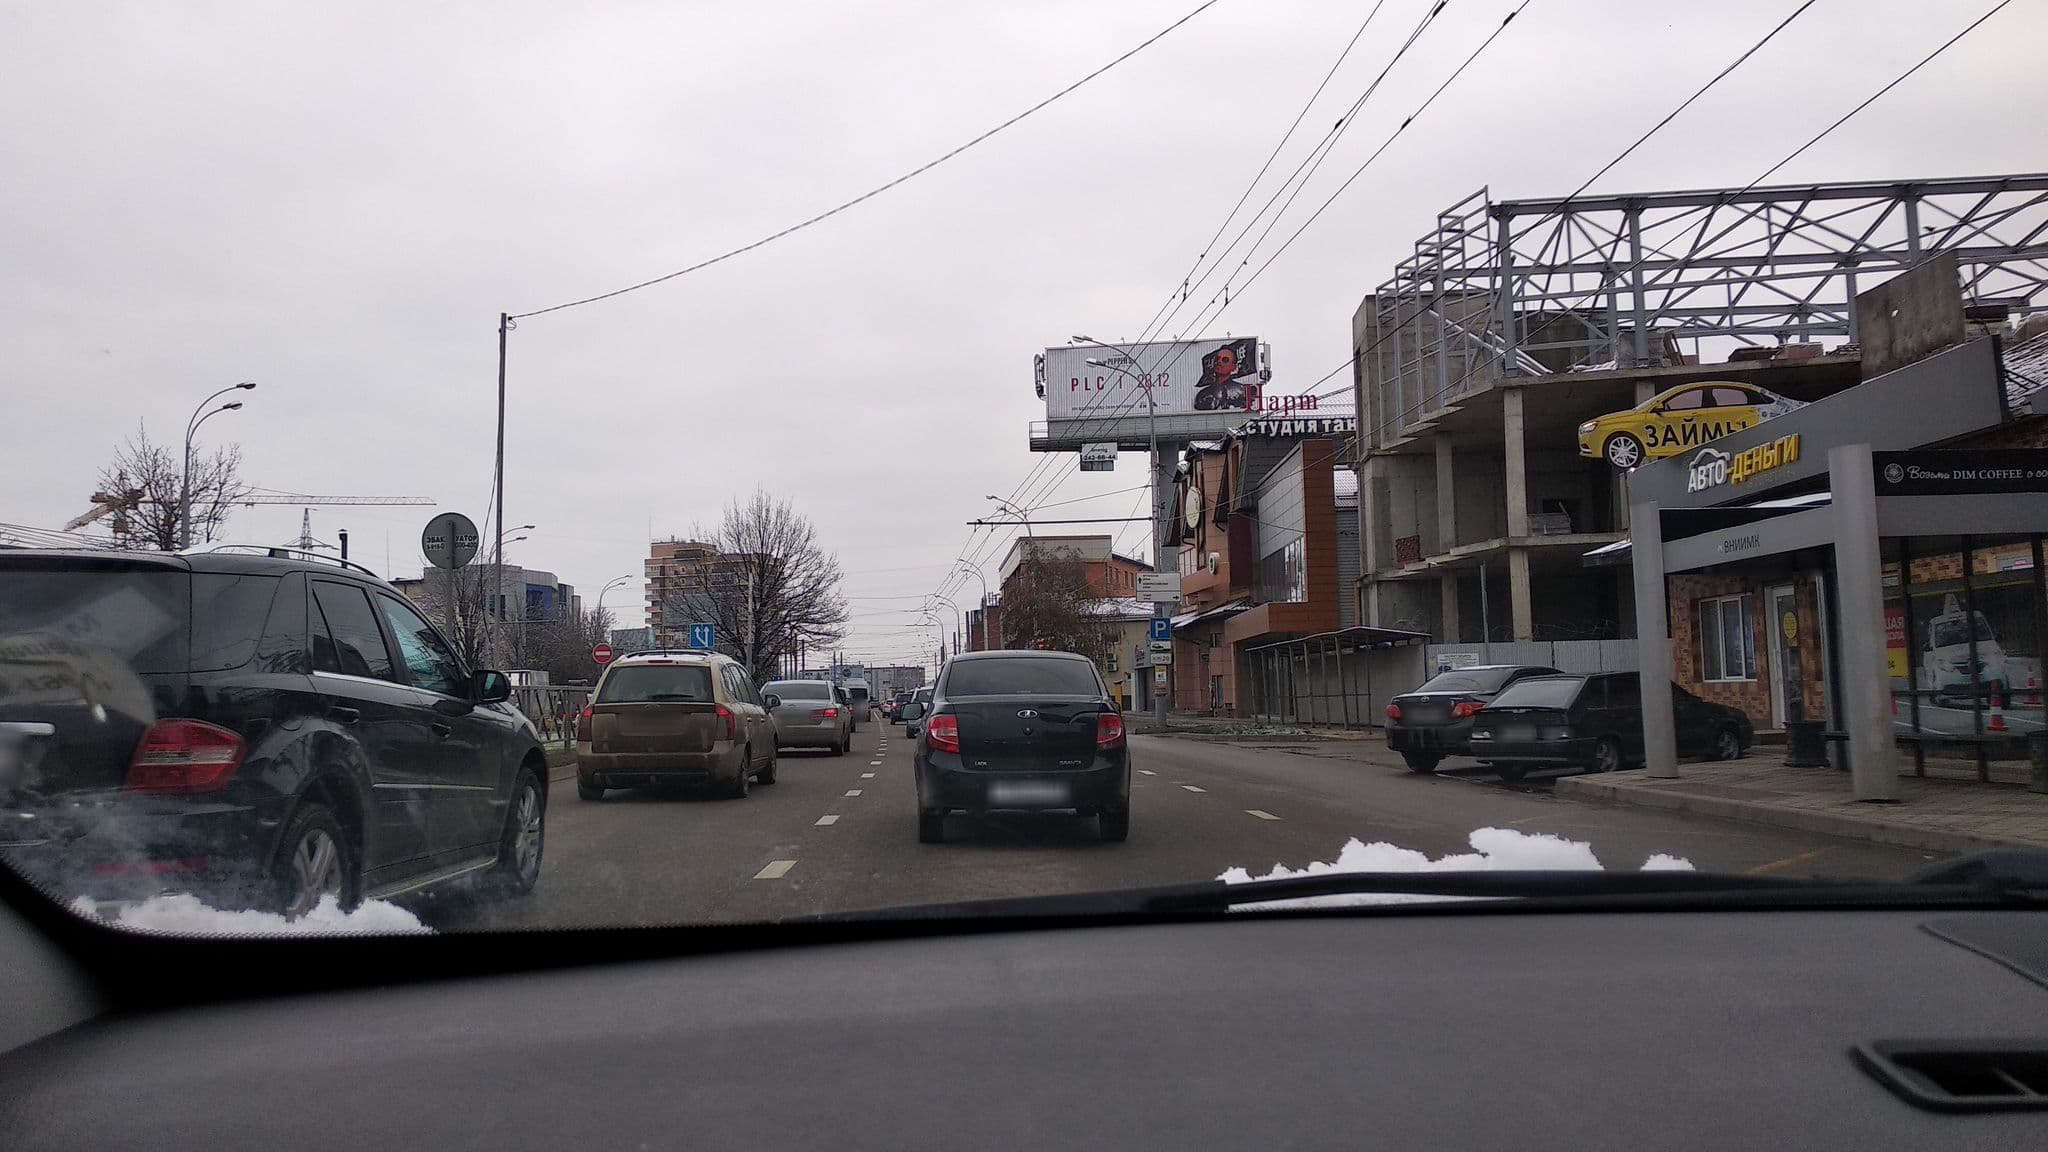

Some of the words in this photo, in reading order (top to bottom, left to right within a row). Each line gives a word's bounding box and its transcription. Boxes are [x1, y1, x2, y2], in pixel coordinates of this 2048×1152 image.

[1071, 376, 1104, 391] PLC
[1244, 384, 1318, 418] Нарт
[1246, 420, 1317, 437] студия
[1688, 433, 1800, 493] АВТО-ДЕНЬГИ
[1953, 470, 1976, 480] DIM
[1979, 469, 2024, 480] COFFEE
[1724, 534, 1760, 553] ВНИИМК
[1155, 621, 1167, 638] P
